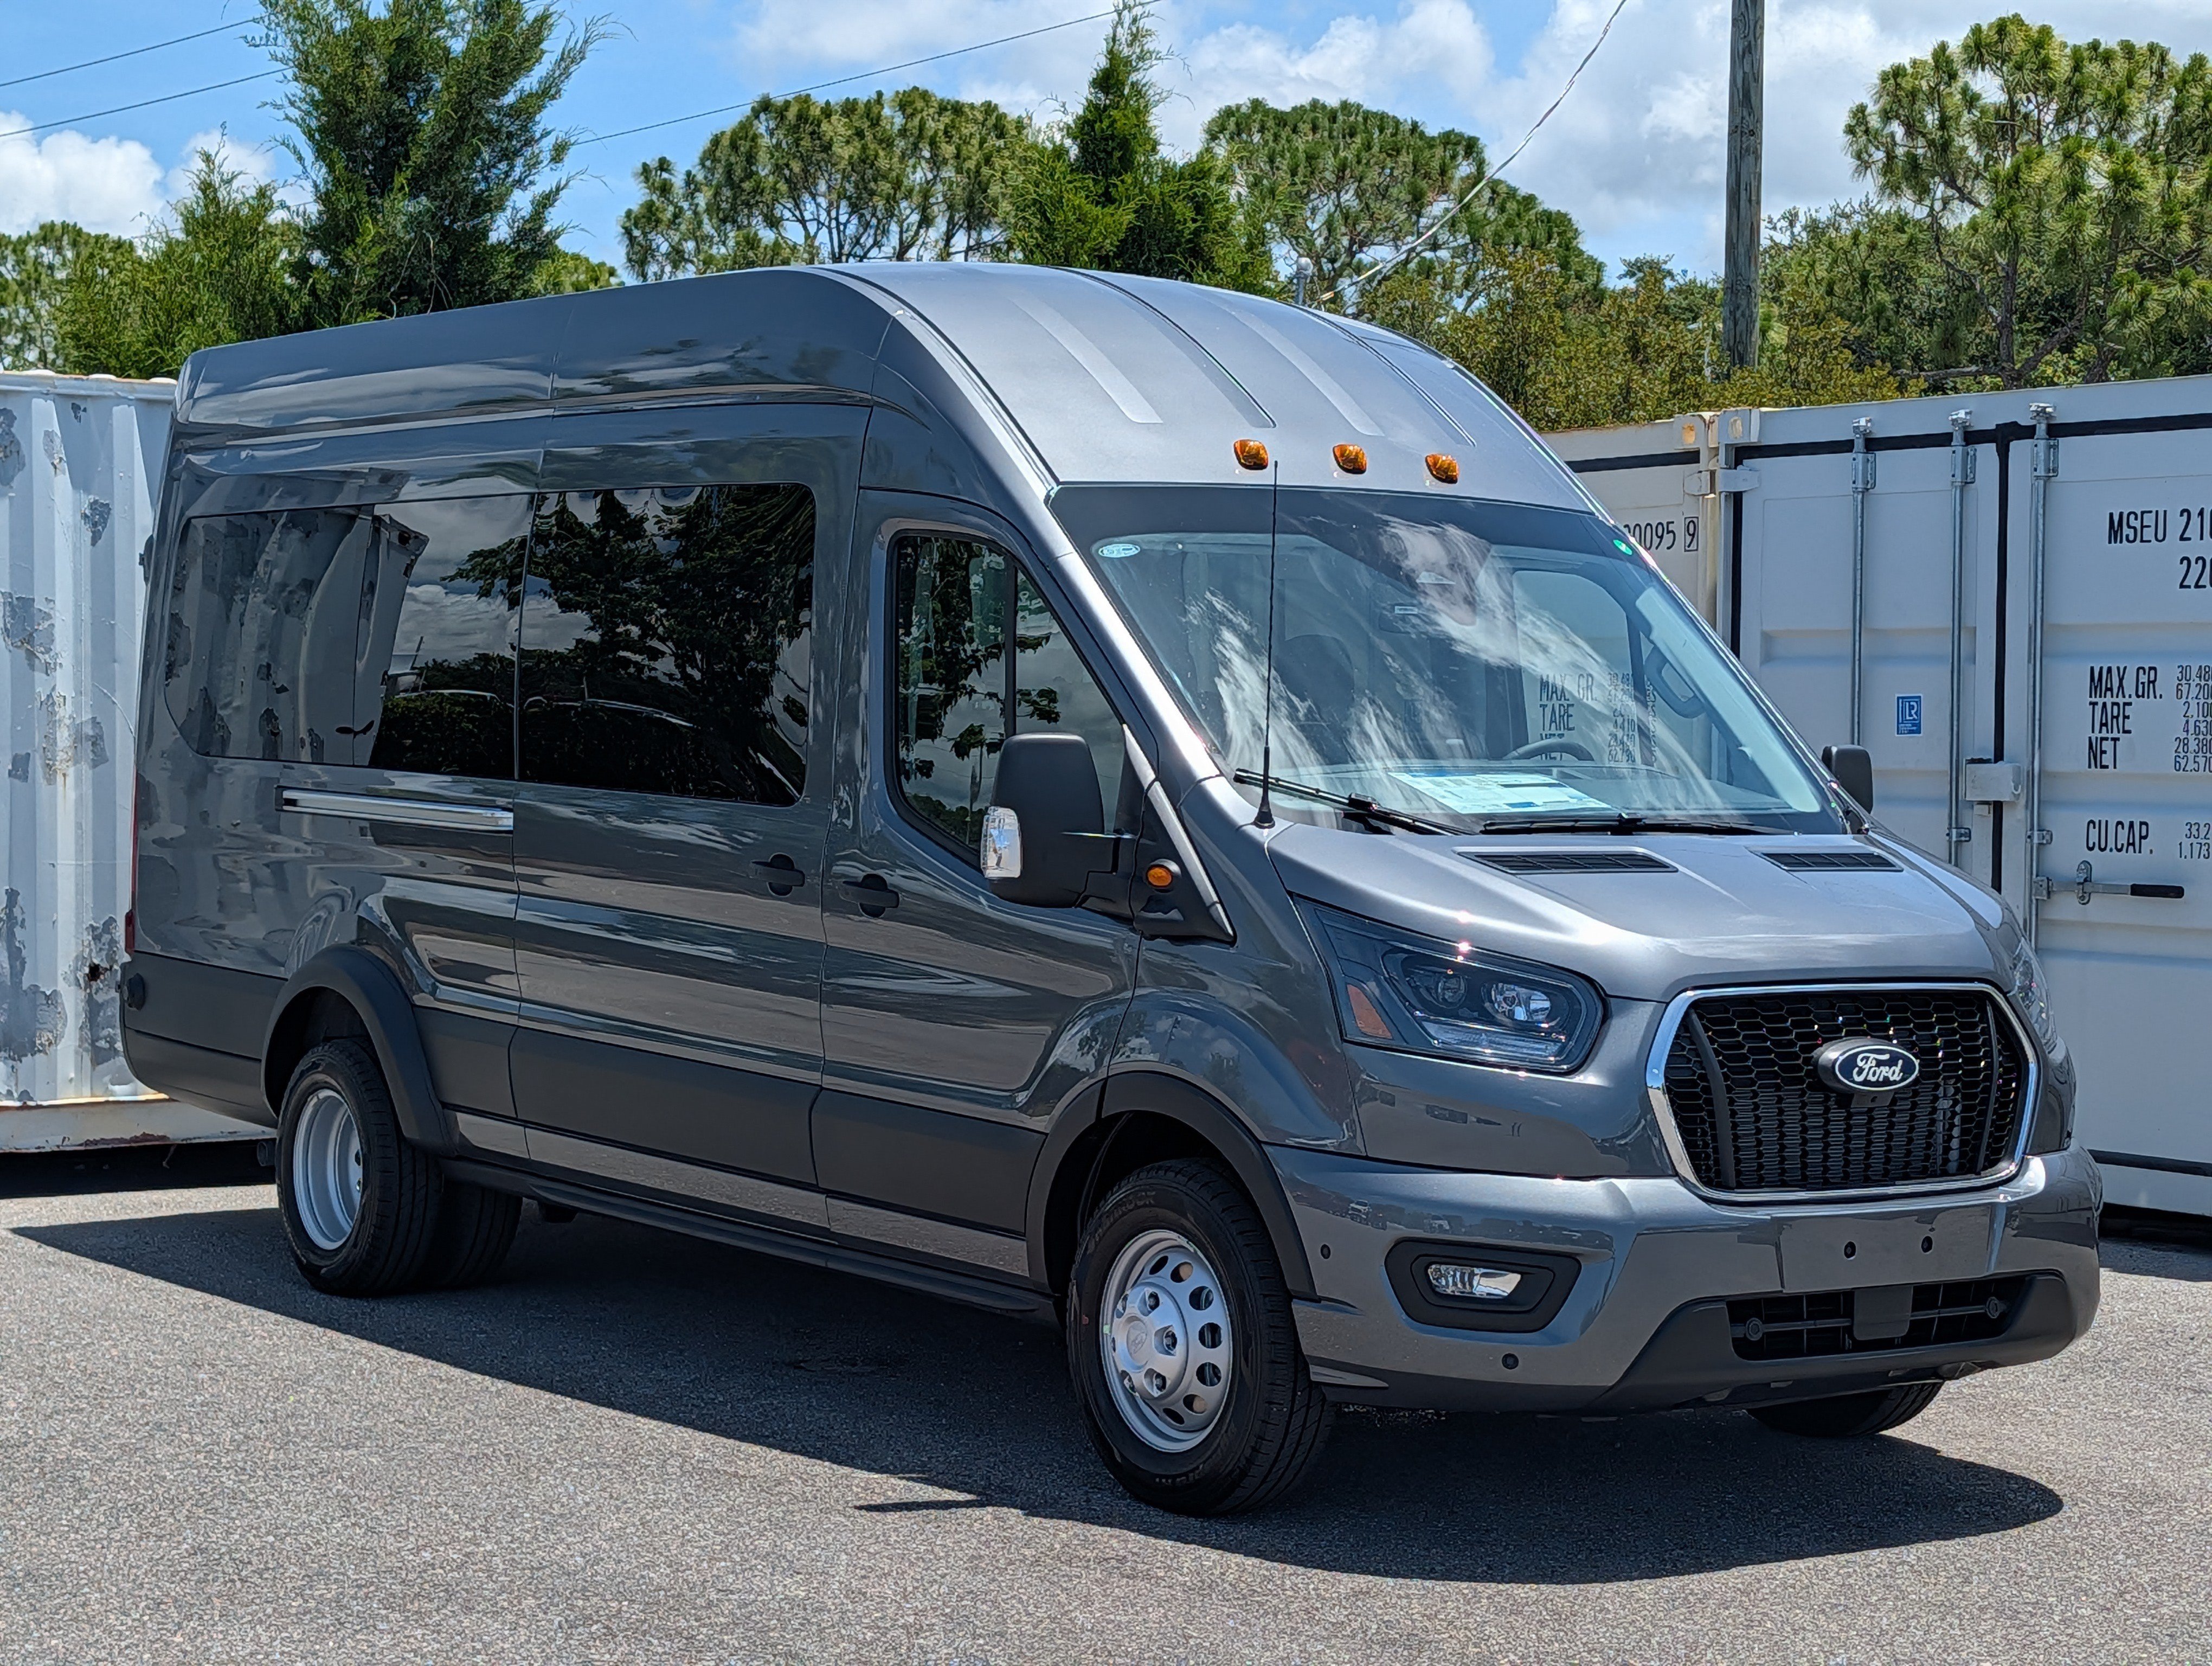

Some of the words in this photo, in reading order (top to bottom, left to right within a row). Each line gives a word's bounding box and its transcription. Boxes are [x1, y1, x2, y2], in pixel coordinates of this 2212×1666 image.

[1686, 519, 1697, 549] 9
[2108, 510, 2168, 544] MSEU
[2179, 507, 2212, 541] 21
[2179, 556, 2212, 589] 22
[2177, 665, 2212, 682] 30.48
[2176, 683, 2212, 700] 67.20
[1539, 703, 1575, 731] TARE
[2088, 701, 2133, 734] TARE
[2087, 736, 2120, 770] NET
[1853, 1053, 1903, 1082] Ford
